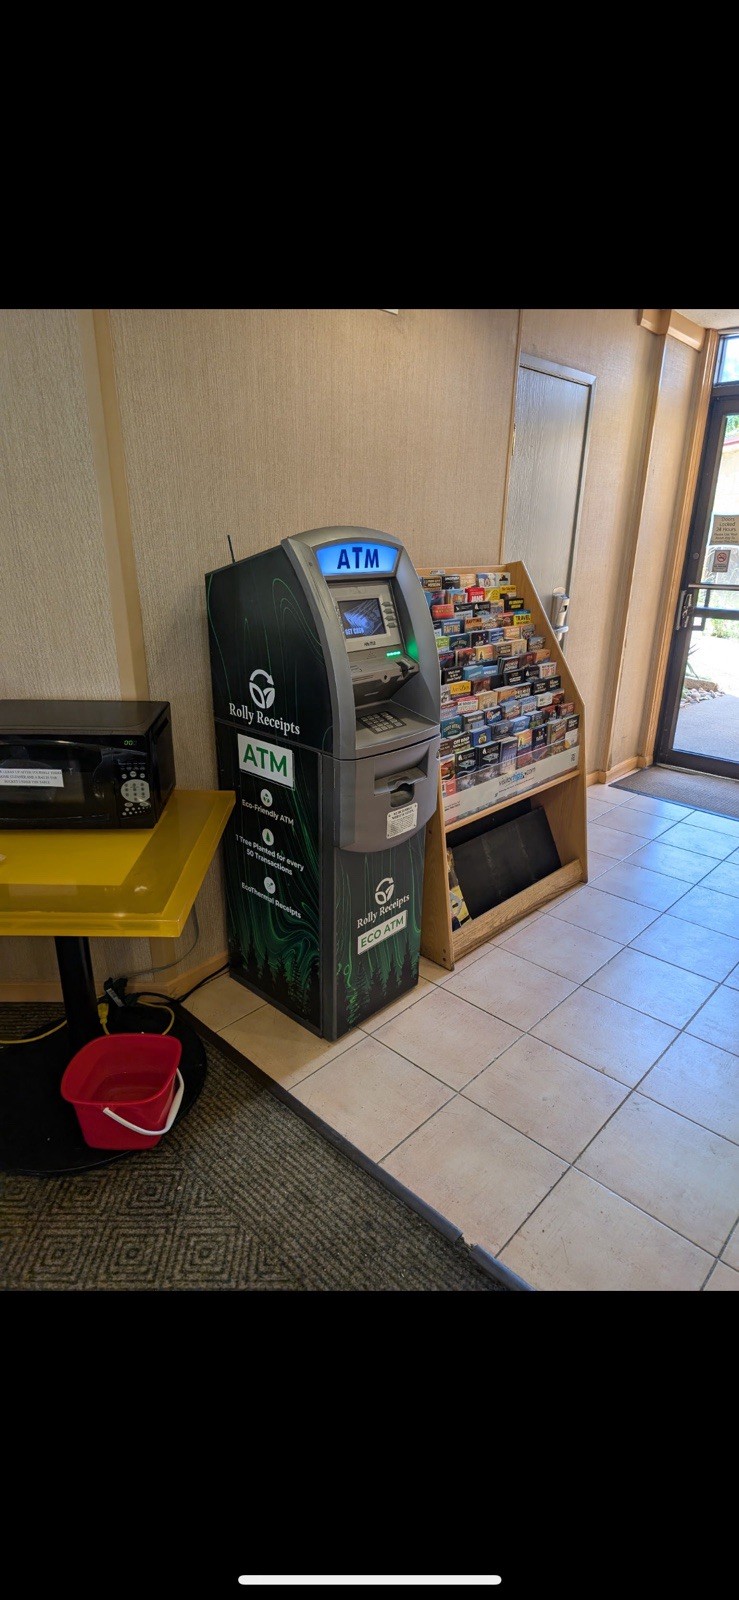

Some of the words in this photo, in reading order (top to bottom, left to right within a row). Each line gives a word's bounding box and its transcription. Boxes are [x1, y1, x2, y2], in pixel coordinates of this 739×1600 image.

[337, 547, 379, 569] ATM
[229, 703, 254, 725] Rolly
[257, 711, 300, 736] Receipts
[243, 744, 287, 777] ATM
[242, 799, 279, 820] Eco-Friendly
[280, 814, 294, 826] ATM
[239, 835, 252, 847] Tree
[253, 841, 276, 858] Planted
[277, 852, 285, 862] for
[286, 858, 304, 872] every
[246, 848, 254, 857] 50
[255, 851, 292, 876] Transactions
[241, 882, 275, 905] EcoThermal
[275, 900, 301, 919] Receipts
[357, 911, 378, 929] Rolly
[379, 894, 409, 916] Receipts
[360, 928, 382, 948] ECO
[383, 915, 404, 934] ATM
